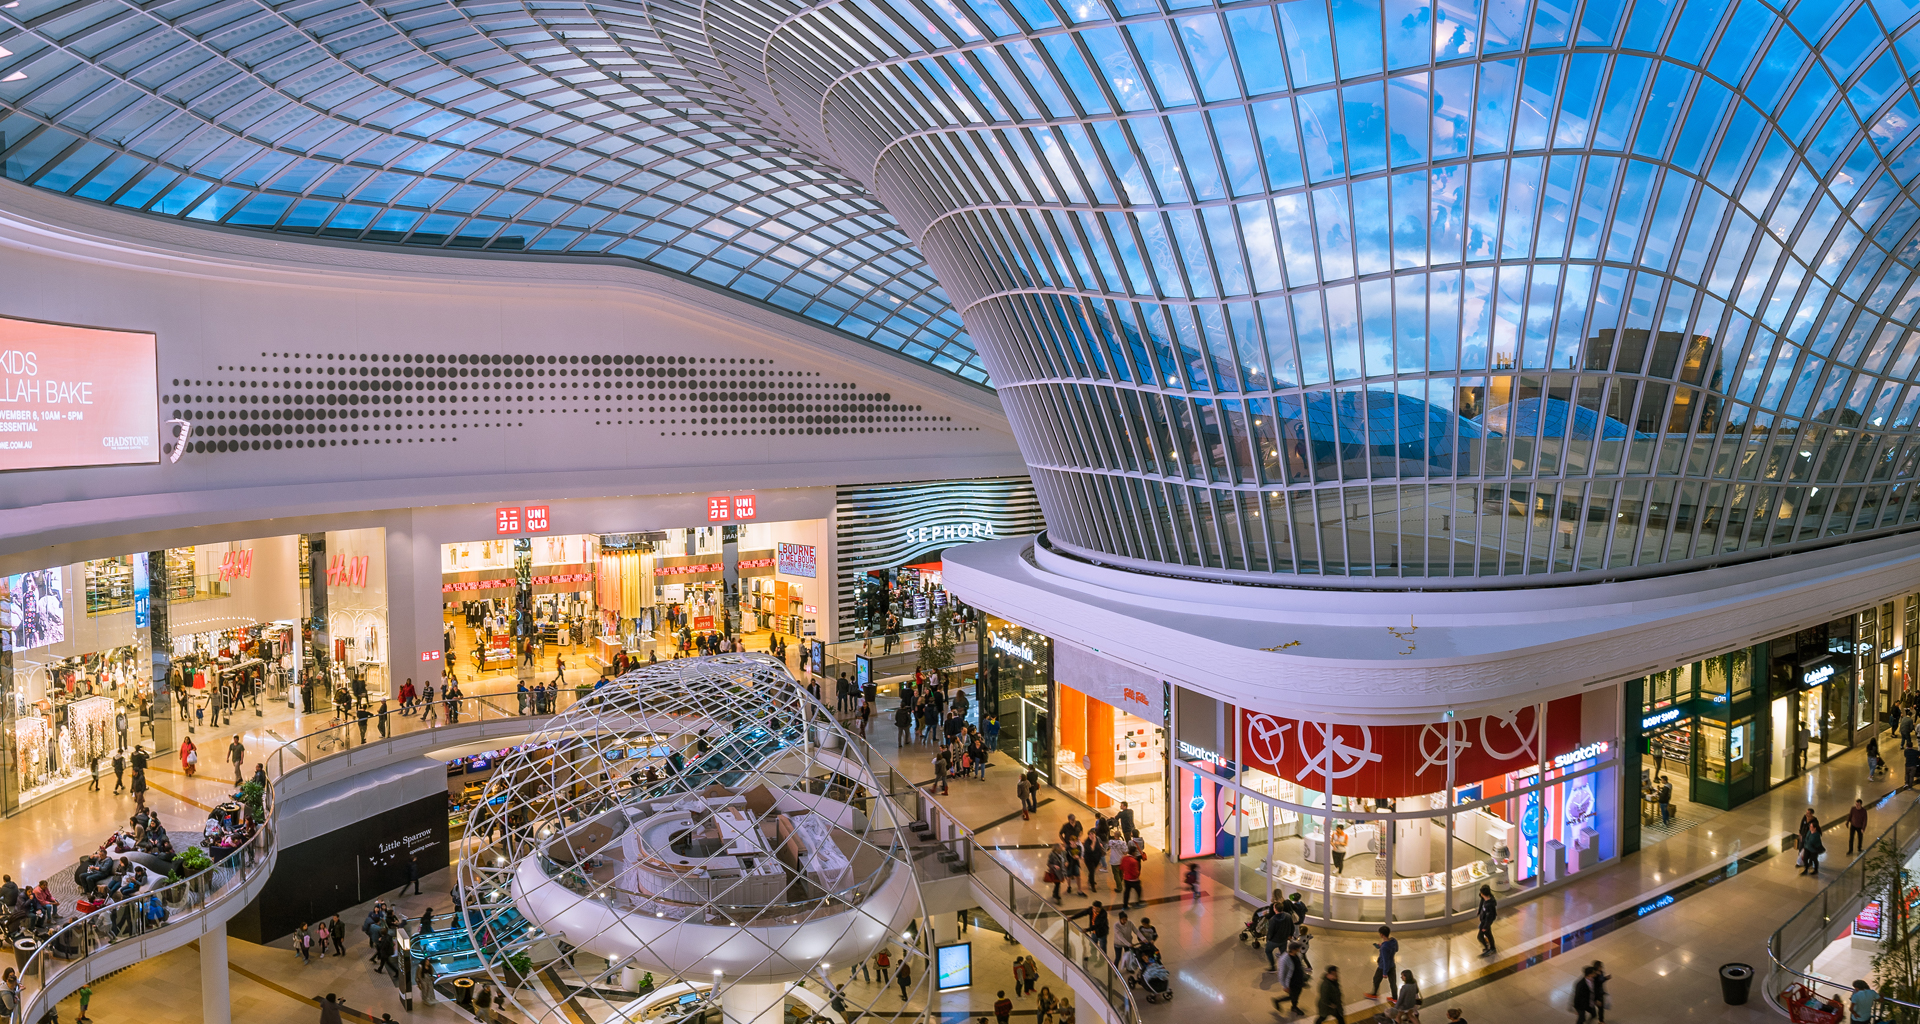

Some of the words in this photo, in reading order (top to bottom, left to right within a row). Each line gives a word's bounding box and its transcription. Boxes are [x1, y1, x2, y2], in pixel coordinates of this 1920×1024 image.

[46, 380, 93, 404] BAKE
[41, 411, 60, 420] 10AM
[68, 411, 83, 420] 5PM
[102, 436, 150, 447] CHADSTONE
[736, 498, 752, 507] UNI
[528, 509, 545, 518] UNI
[736, 508, 754, 518] QLO
[528, 519, 547, 530] QLO
[906, 522, 994, 544] SEPHORA
[218, 548, 253, 582] H&M
[324, 554, 368, 588] H&M
[1642, 714, 1661, 728] BODY
[1660, 709, 1680, 722] SHOP
[1180, 742, 1218, 766] swatch
[1554, 742, 1600, 768] swatch
[379, 840, 400, 854] Little
[402, 828, 432, 848] Sparrow
